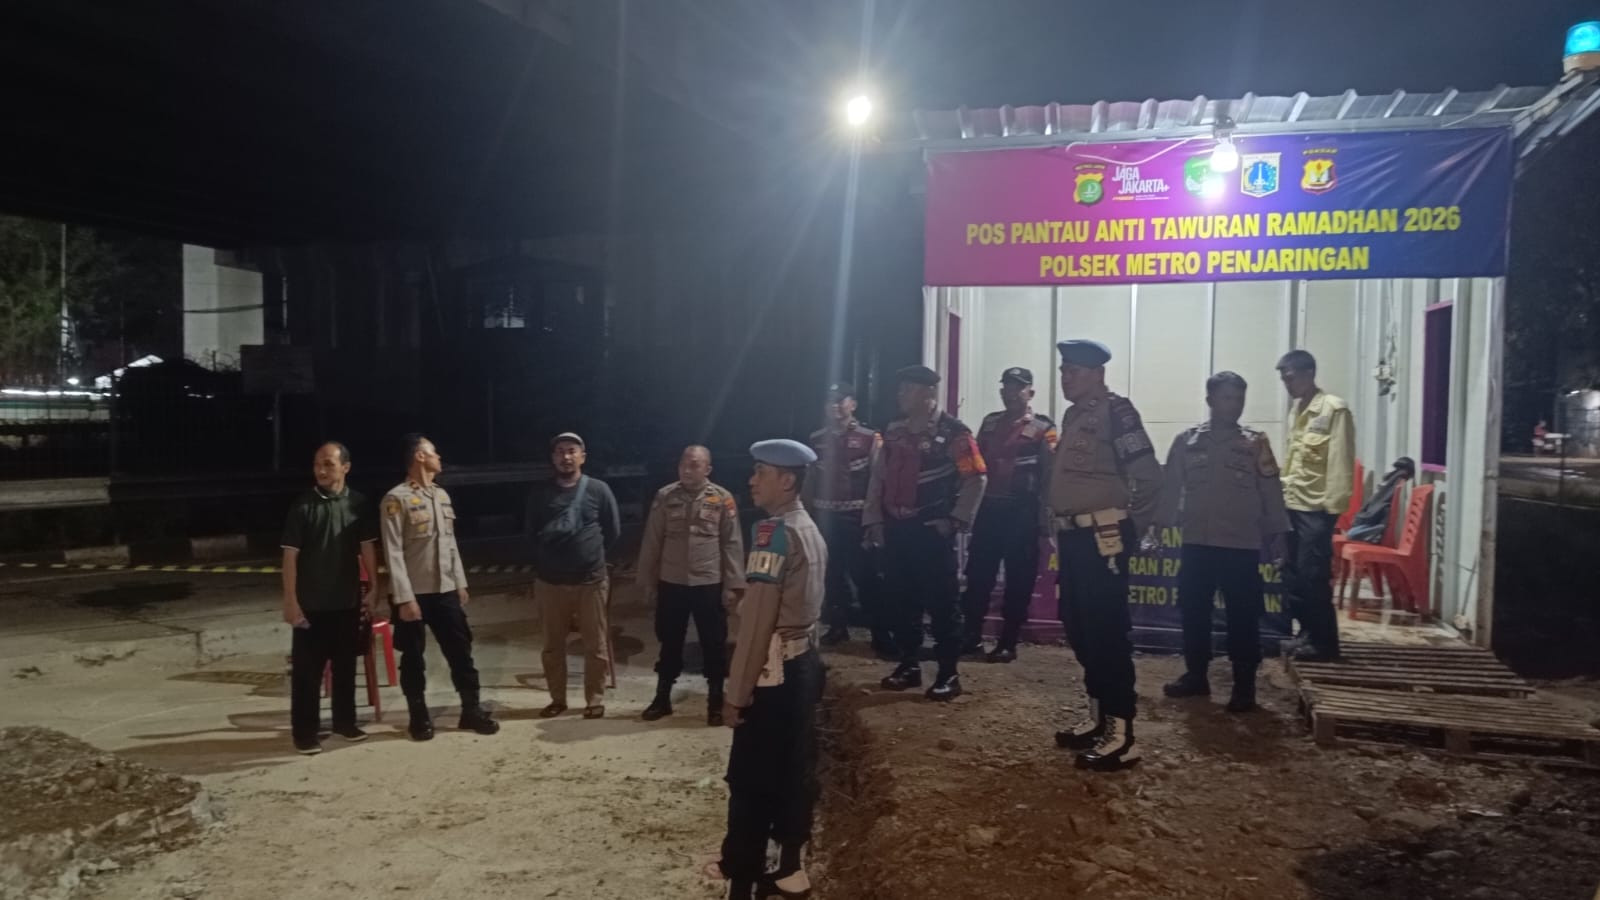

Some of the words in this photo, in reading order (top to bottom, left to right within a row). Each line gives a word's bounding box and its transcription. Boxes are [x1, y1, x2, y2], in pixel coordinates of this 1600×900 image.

[1112, 166, 1140, 181] JAGA
[966, 223, 1005, 246] POS
[1010, 220, 1090, 244] PANTAU
[1094, 218, 1145, 242] ANTI
[1151, 213, 1260, 240] TAWURAN
[1266, 208, 1398, 236] RAMADHAN
[1403, 206, 1461, 232] 2026
[1039, 254, 1120, 278] POLSEK
[1126, 252, 1201, 276] METRO
[1207, 247, 1369, 274] PENJARINGAN
[1128, 585, 1167, 606] ETRO
